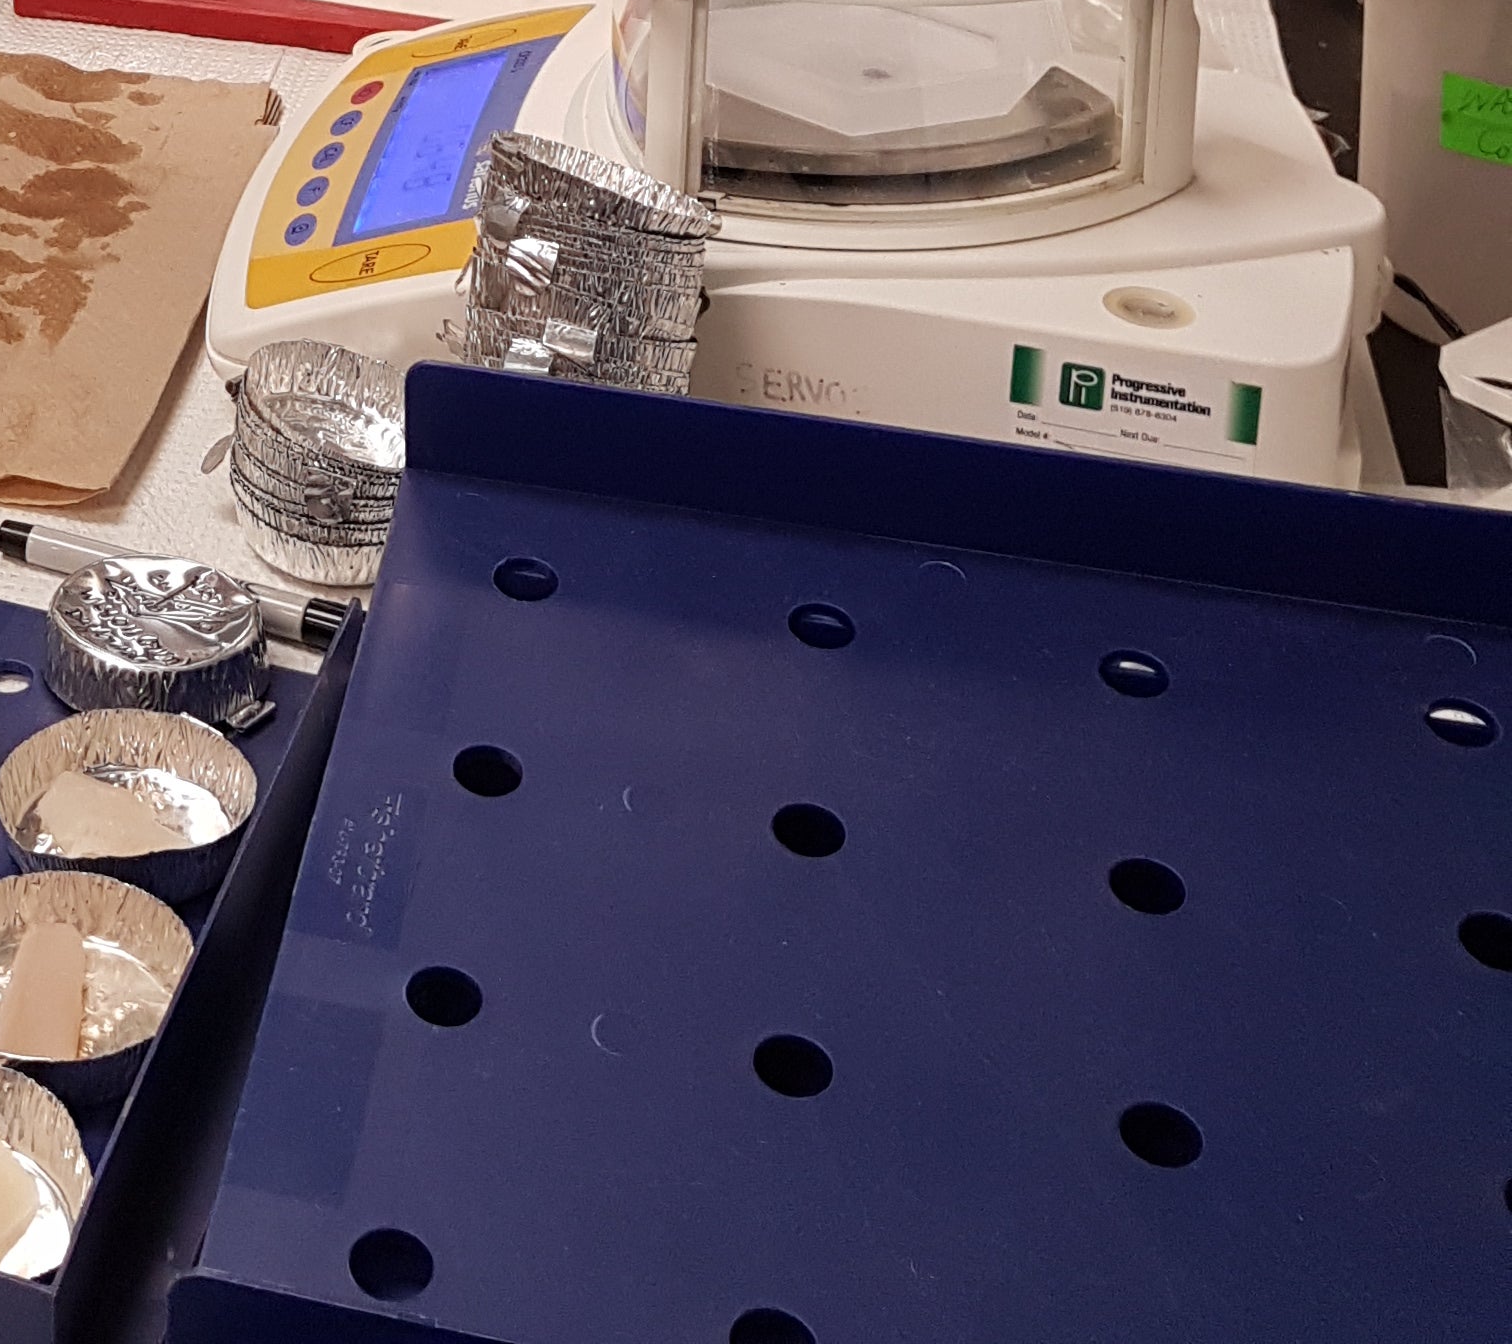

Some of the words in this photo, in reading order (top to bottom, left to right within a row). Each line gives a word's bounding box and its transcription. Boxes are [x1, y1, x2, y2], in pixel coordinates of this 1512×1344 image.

[359, 250, 380, 276] TARE
[1111, 373, 1187, 398] Progressive
[1110, 388, 1212, 417] Instrumentation
[1015, 427, 1041, 439] Model
[1120, 429, 1139, 440] Next
